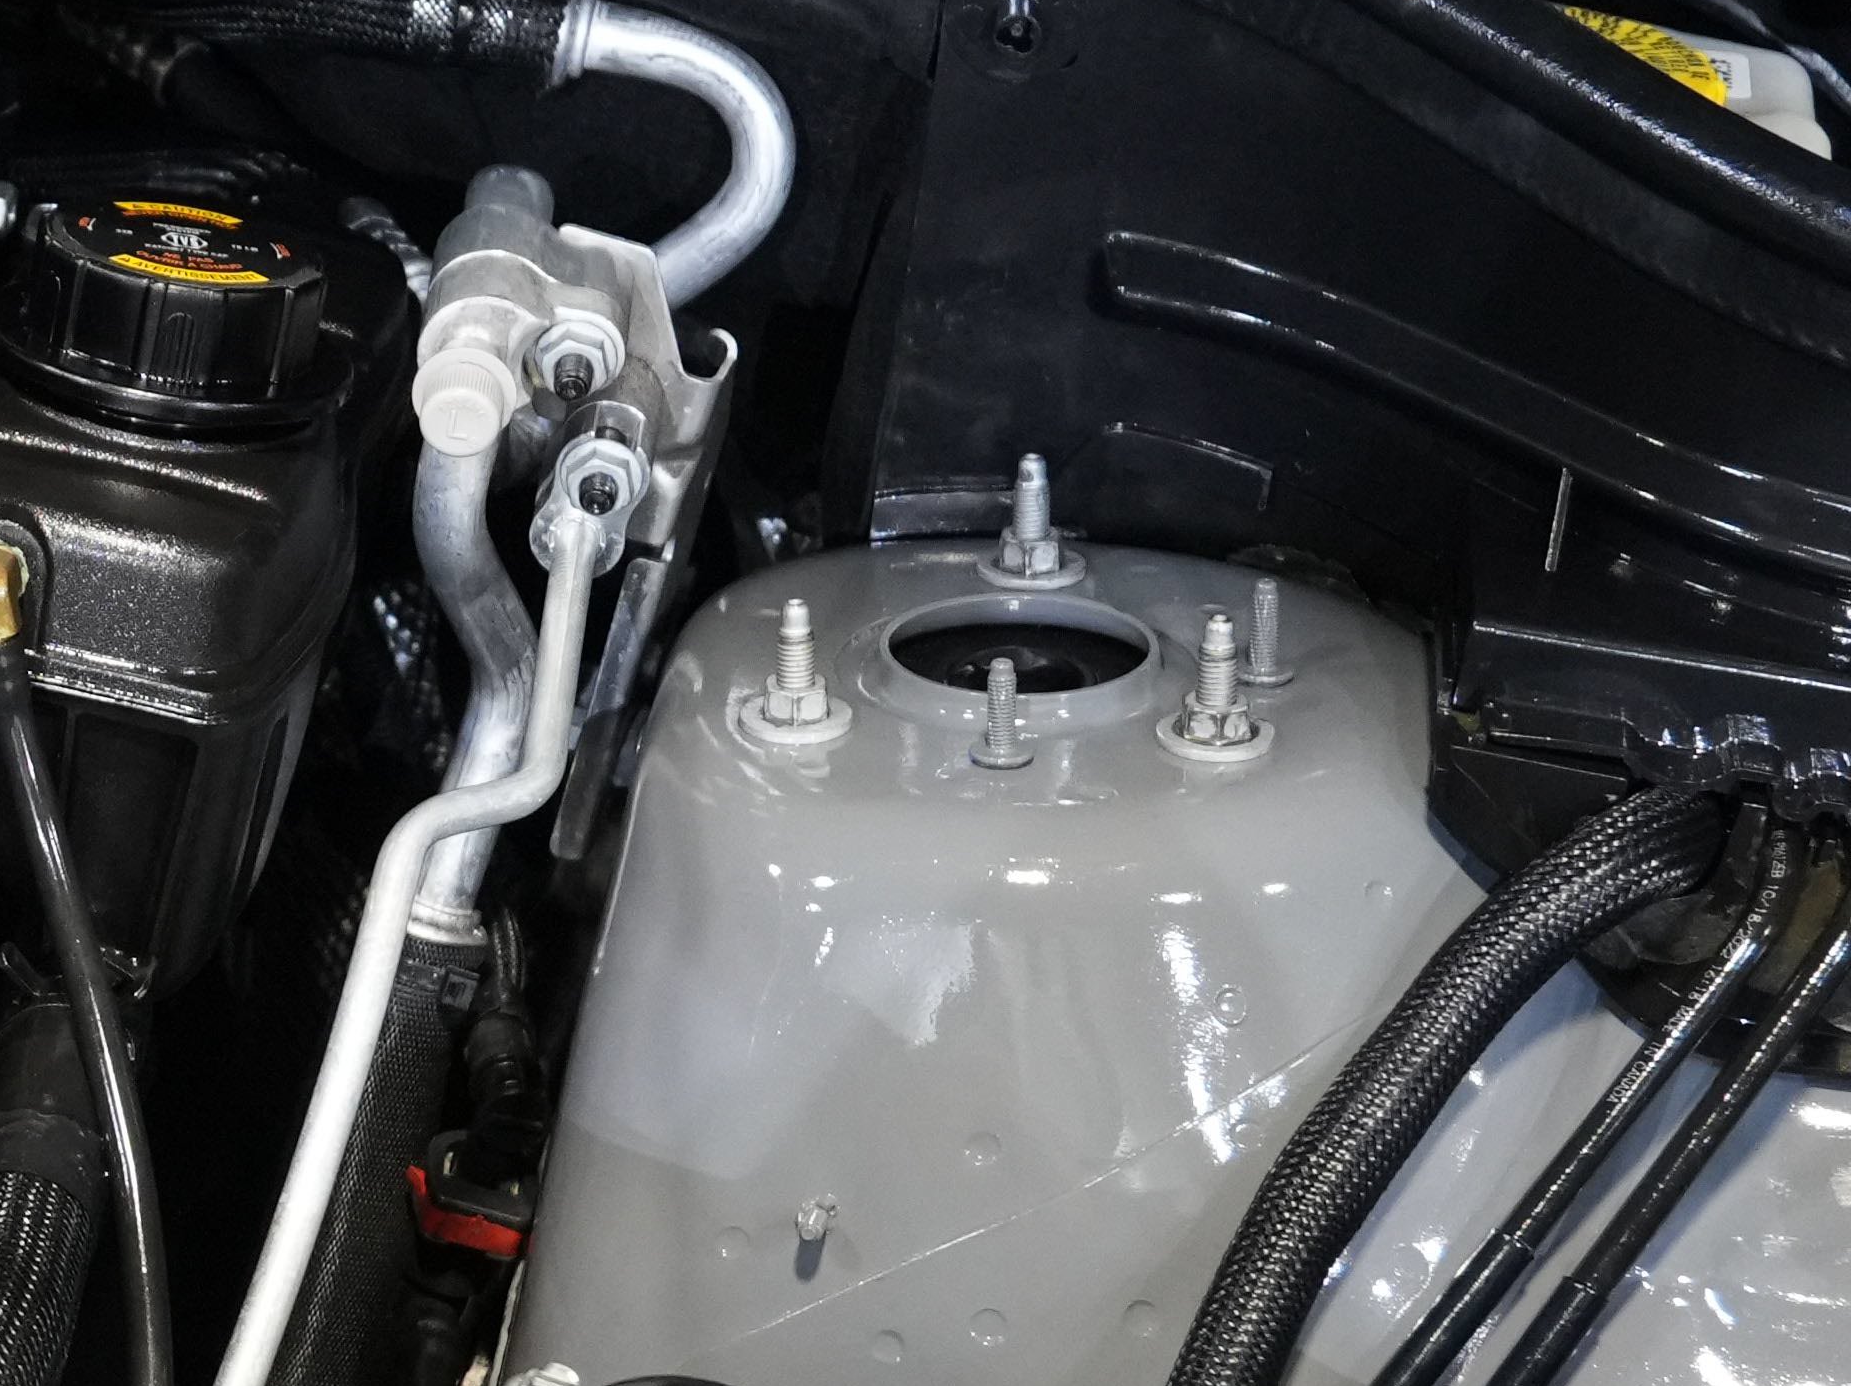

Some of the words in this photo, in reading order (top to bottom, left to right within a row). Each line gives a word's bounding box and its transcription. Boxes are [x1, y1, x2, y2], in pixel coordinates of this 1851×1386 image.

[147, 204, 227, 222] CAUTION
[132, 259, 261, 283] AVERTISSEMENT
[1605, 1060, 1647, 1107] CANADA
